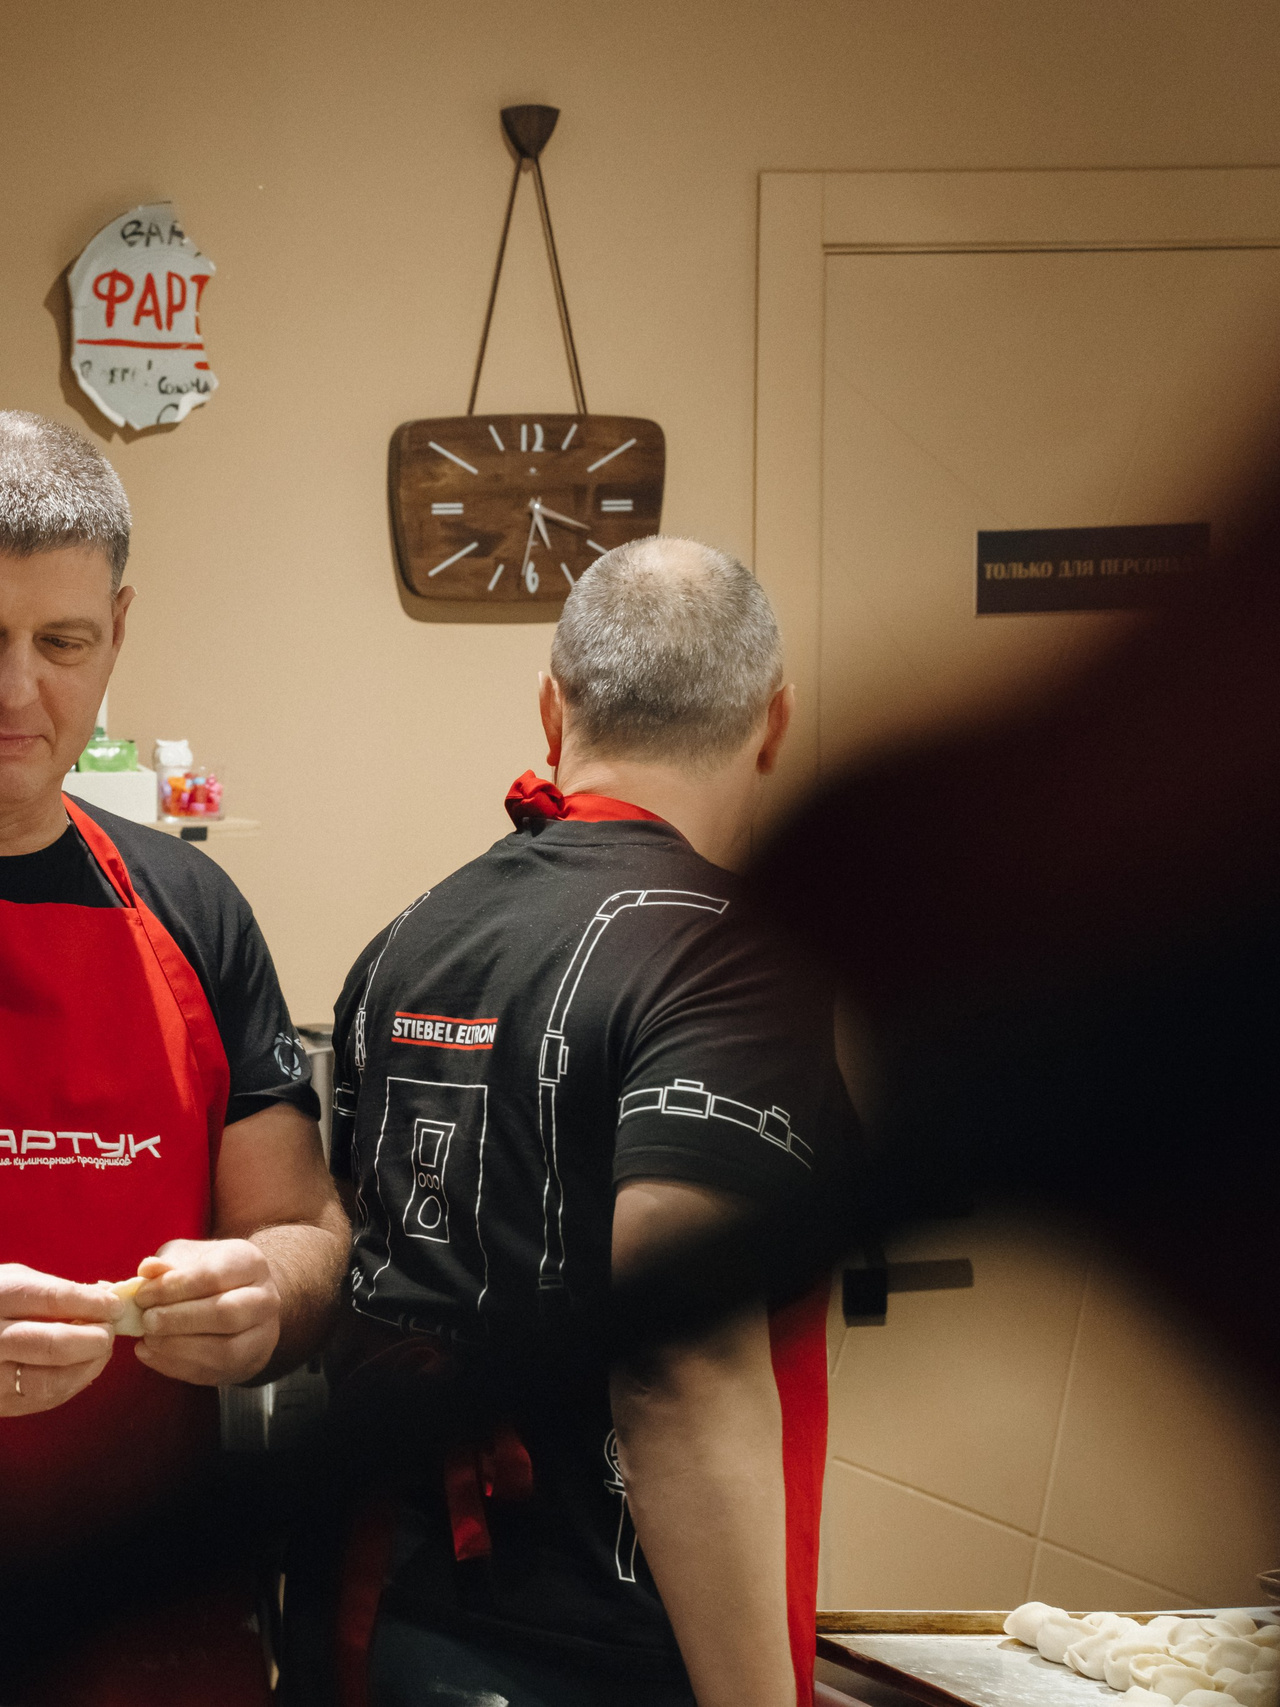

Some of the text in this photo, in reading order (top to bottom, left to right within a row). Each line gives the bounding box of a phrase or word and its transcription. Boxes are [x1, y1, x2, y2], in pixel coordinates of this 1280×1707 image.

[92, 268, 211, 336] ФАРТ
[520, 423, 544, 452] 12
[525, 561, 540, 593] 6
[984, 561, 1053, 580] ТОЛЬКО
[1058, 559, 1094, 577] ДЛЯ
[392, 1018, 453, 1042] STIEBEL
[13, 1155, 76, 1170] кулинарных
